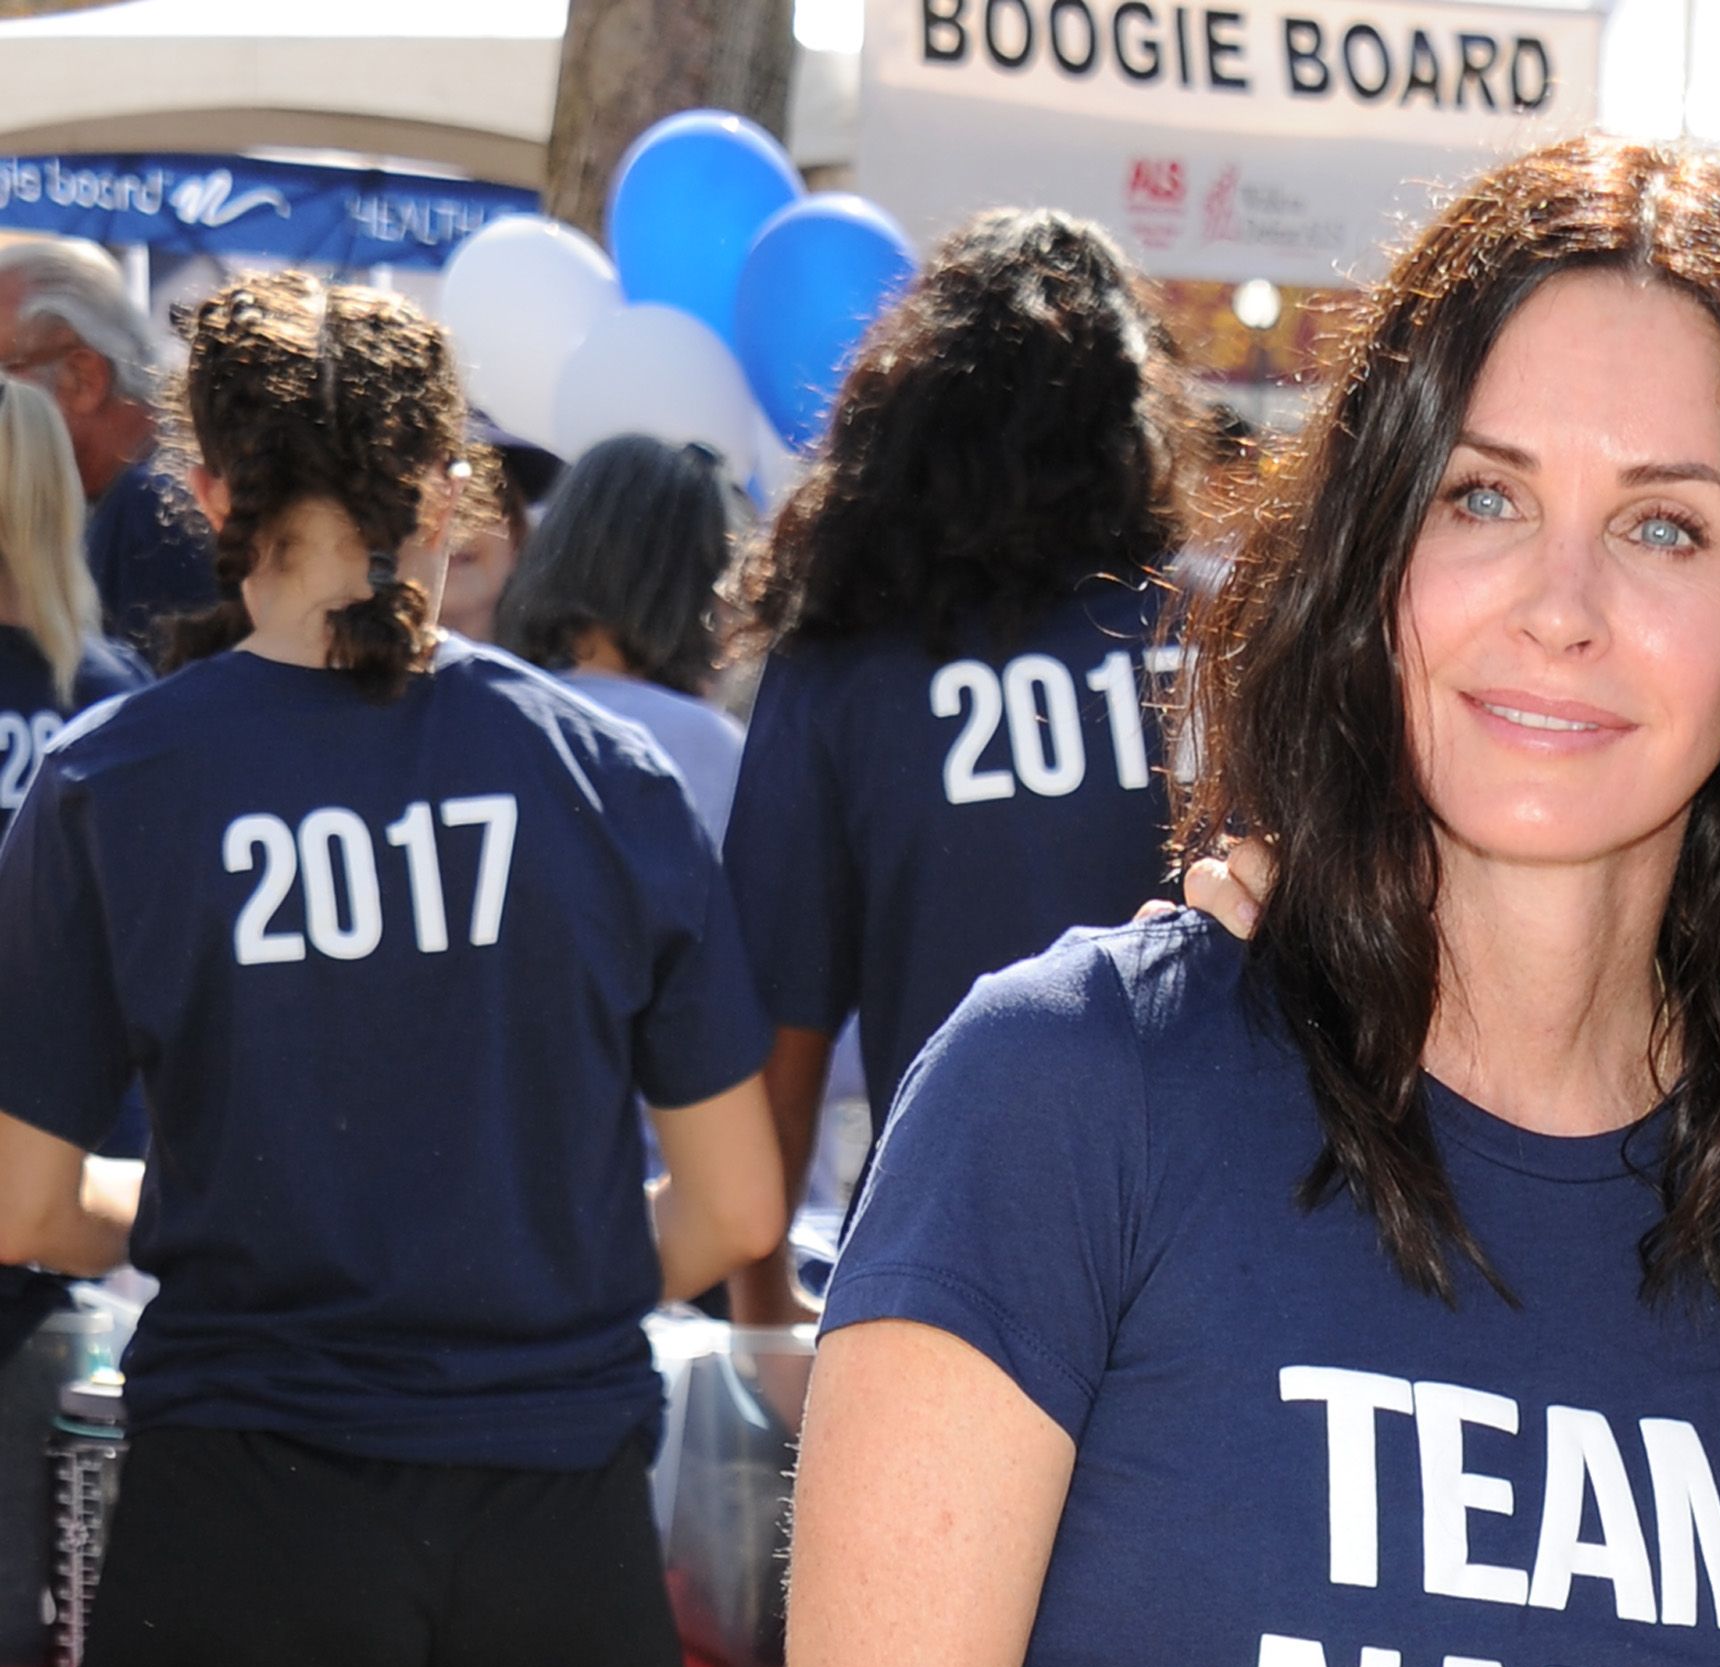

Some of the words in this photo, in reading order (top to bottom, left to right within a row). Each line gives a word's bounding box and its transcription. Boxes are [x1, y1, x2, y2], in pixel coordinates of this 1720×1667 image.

[922, 0, 1250, 90] BOOGIE
[1283, 17, 1551, 110] BOARD
[222, 793, 518, 966] 2017
